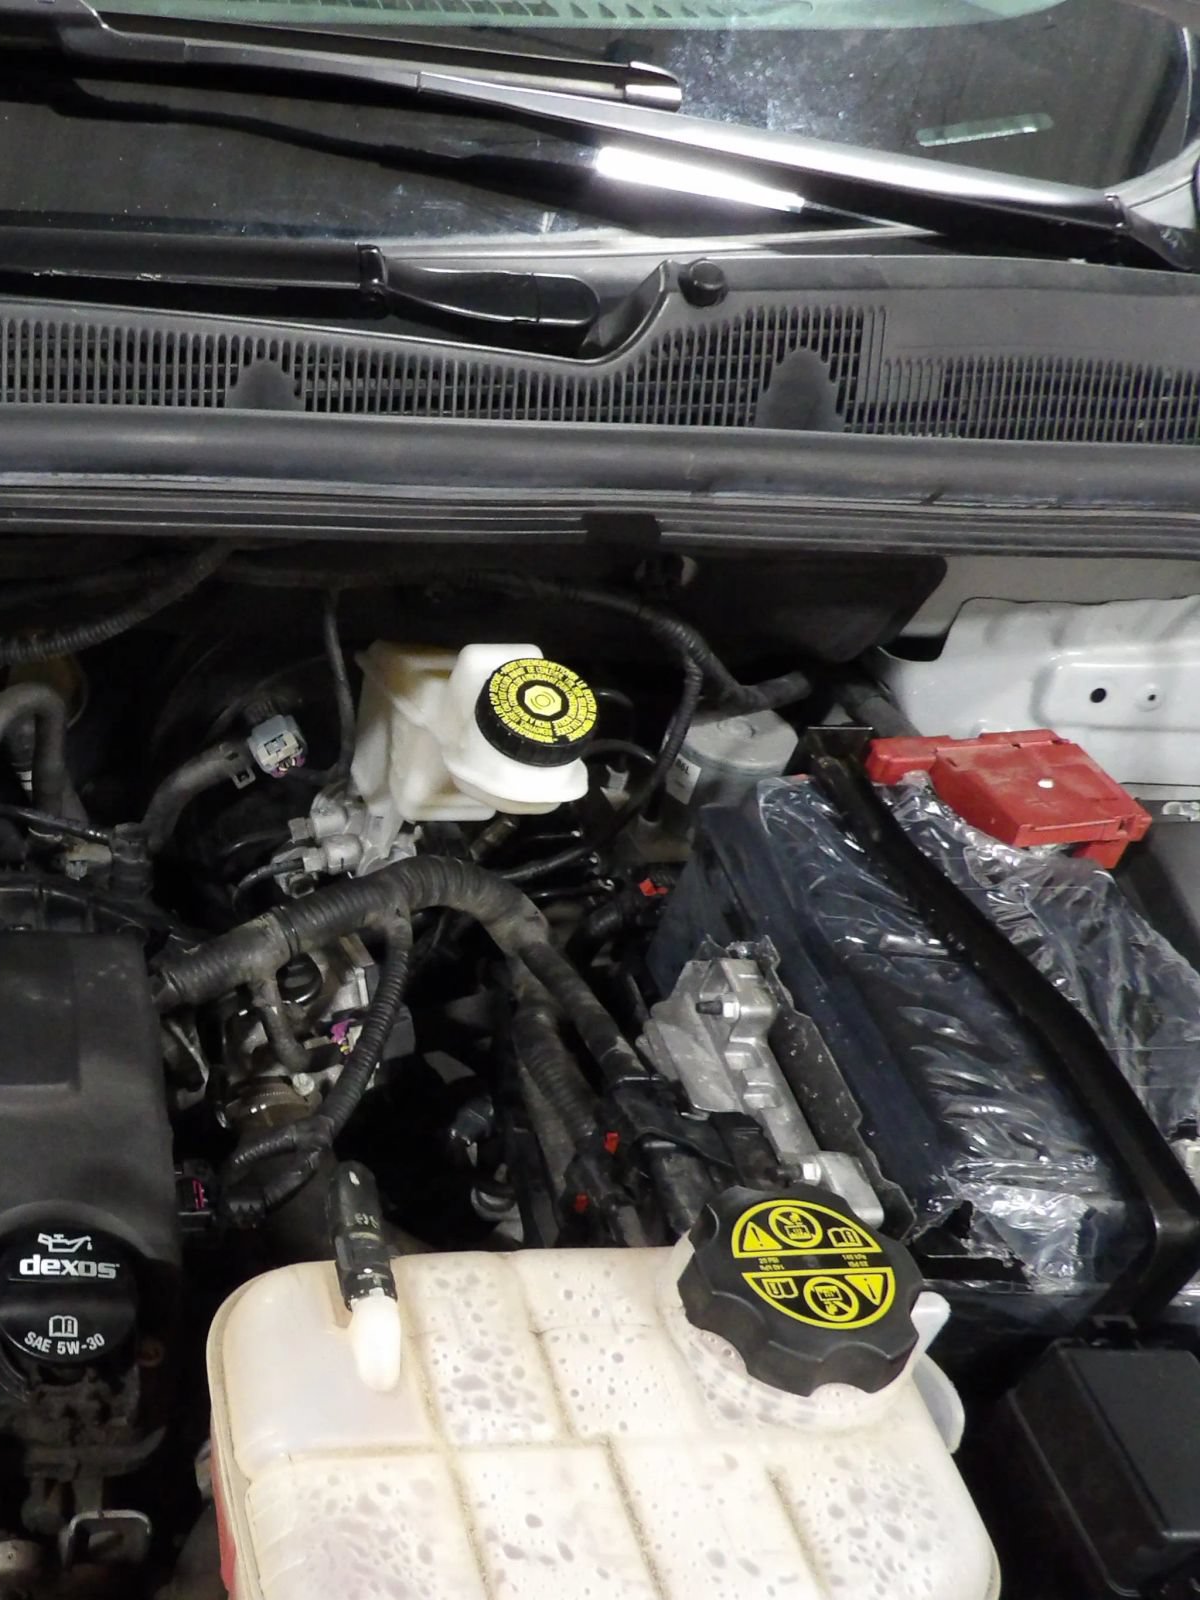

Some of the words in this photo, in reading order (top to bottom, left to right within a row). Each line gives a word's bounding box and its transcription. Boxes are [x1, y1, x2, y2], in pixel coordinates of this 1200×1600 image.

[489, 692, 500, 705] CAP
[19, 1254, 117, 1279] dexos
[24, 1331, 52, 1353] SAE
[57, 1333, 105, 1355] 5W-30
